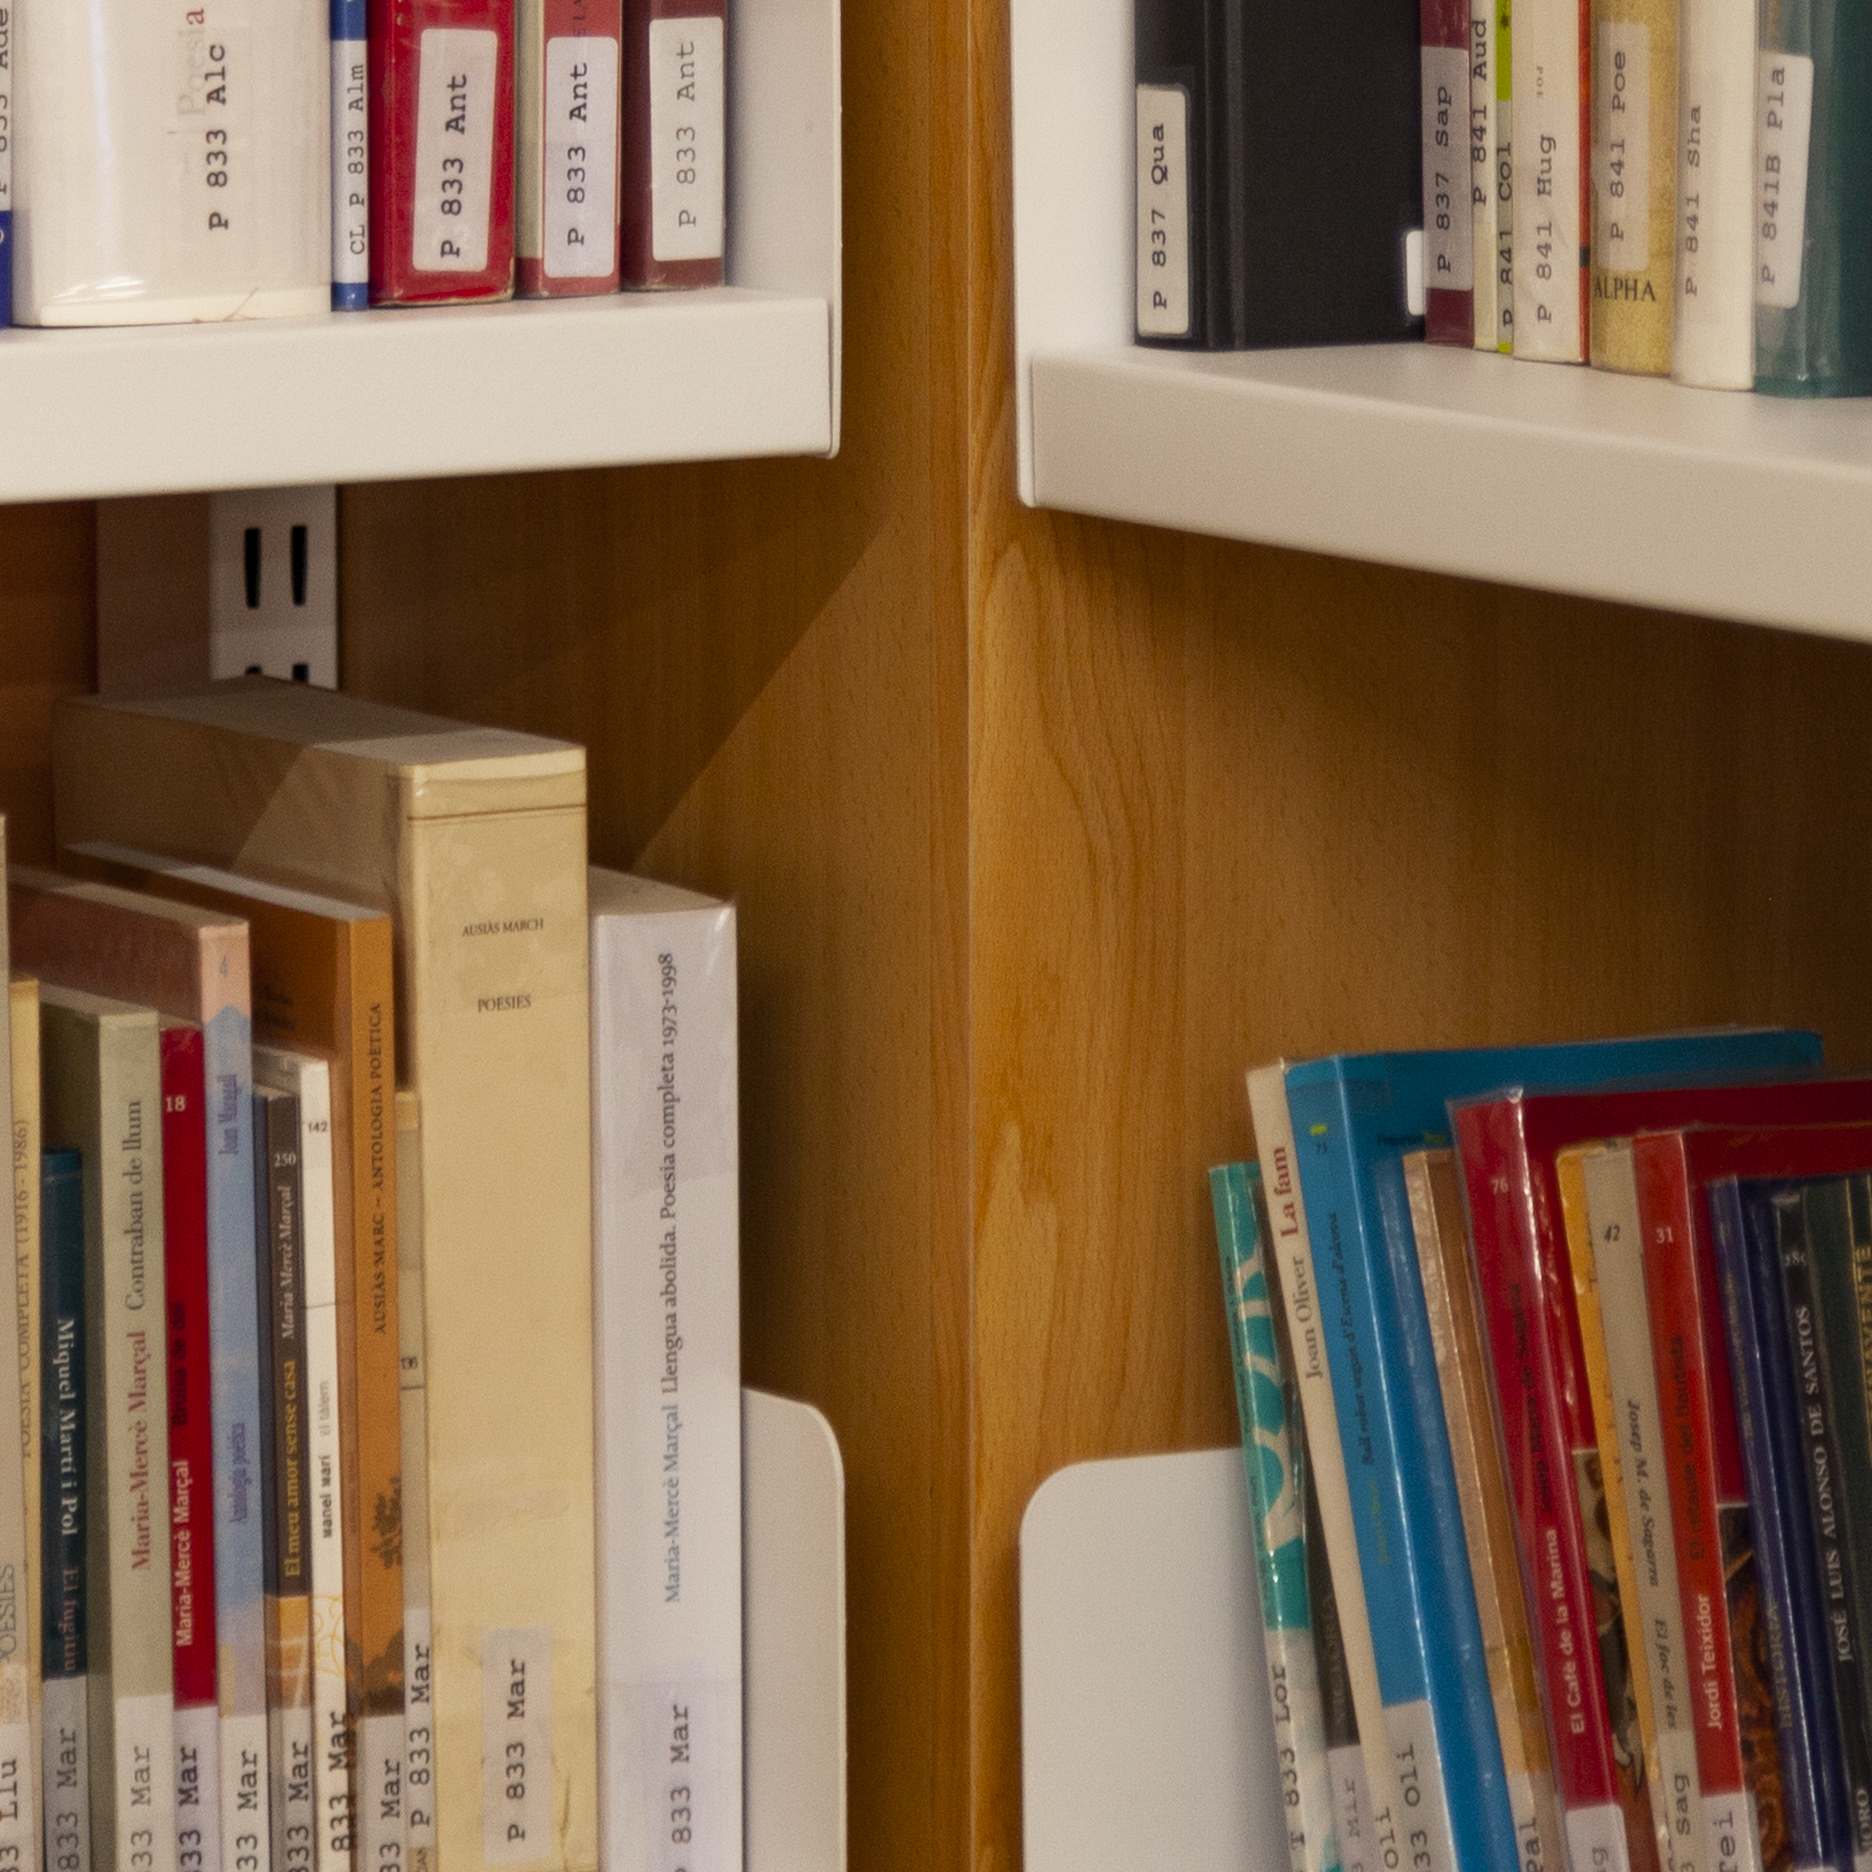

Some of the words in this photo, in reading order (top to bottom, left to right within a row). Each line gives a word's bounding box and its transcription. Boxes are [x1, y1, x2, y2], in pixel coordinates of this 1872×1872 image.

[205, 43, 227, 105] Alc
[569, 63, 588, 122] Ant
[206, 129, 227, 188] 833
[568, 146, 586, 203] 833
[1150, 123, 1167, 185] Qua
[1536, 134, 1556, 196] Hug
[208, 211, 228, 230] P
[568, 228, 585, 245] P
[1151, 209, 1166, 268] 837
[1536, 220, 1553, 280] 841
[1151, 290, 1167, 310] P
[1536, 304, 1552, 323] P
[654, 952, 682, 1048] 1973-1998
[658, 1052, 682, 1148] completa
[657, 1152, 679, 1220] Poesia
[1270, 1146, 1292, 1196] fam
[1279, 1202, 1300, 1238] La
[1290, 1256, 1313, 1322] Oliver
[660, 1313, 682, 1393] Llengua
[1302, 1327, 1324, 1380] Joan
[1694, 1593, 1716, 1671] Teixidor
[507, 1659, 525, 1719] Mar
[1702, 1677, 1724, 1729] Jordi
[507, 1742, 525, 1800] 833
[508, 1824, 525, 1842] P
